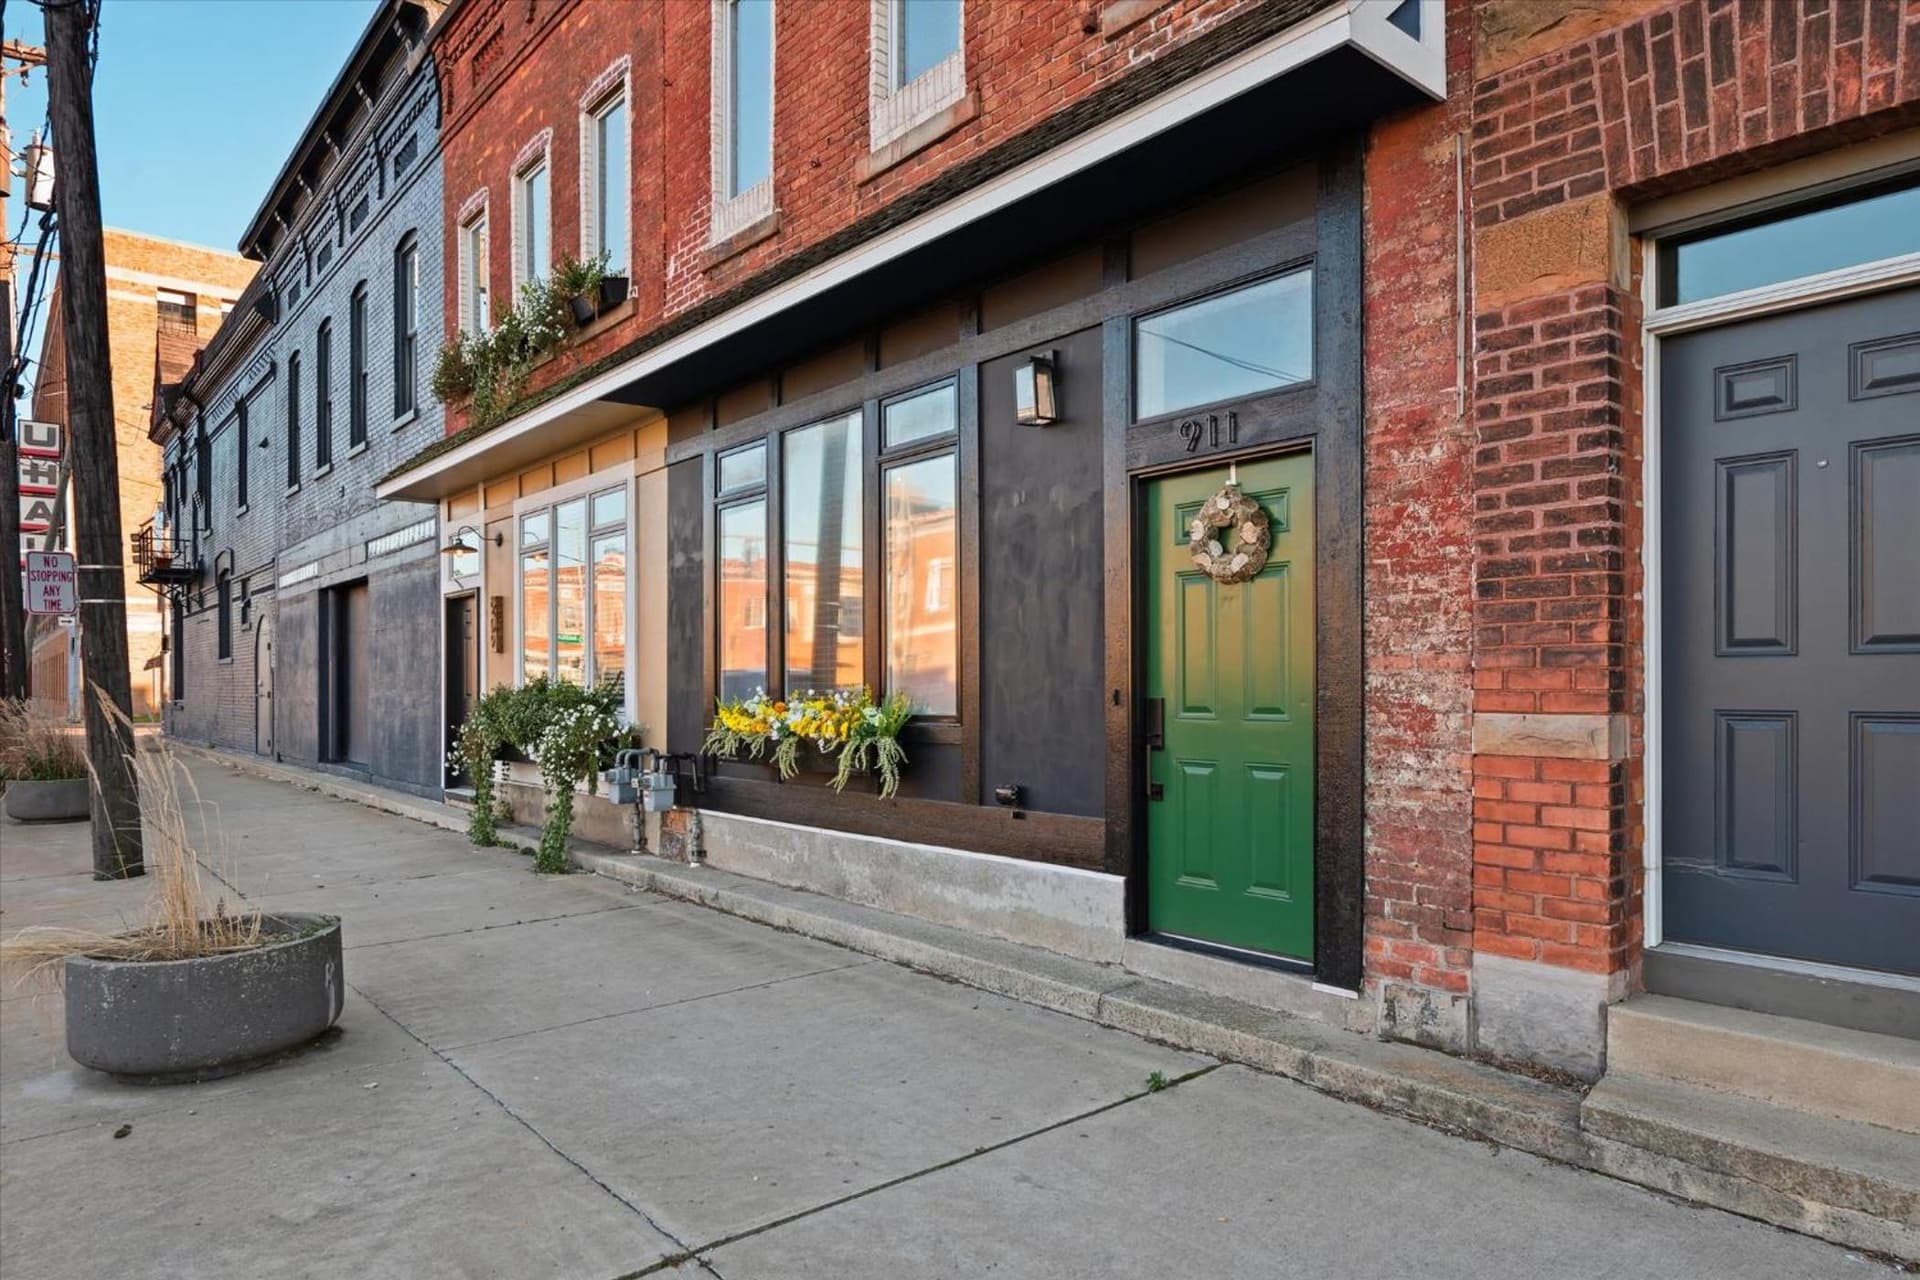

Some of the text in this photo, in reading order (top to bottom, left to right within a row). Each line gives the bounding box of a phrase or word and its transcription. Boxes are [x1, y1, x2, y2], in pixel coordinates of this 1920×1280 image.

[1179, 411, 1238, 453] 911
[43, 556, 58, 568] NO
[30, 570, 73, 583] STOPPING
[43, 585, 61, 597] ANY
[43, 599, 62, 611] TIME
